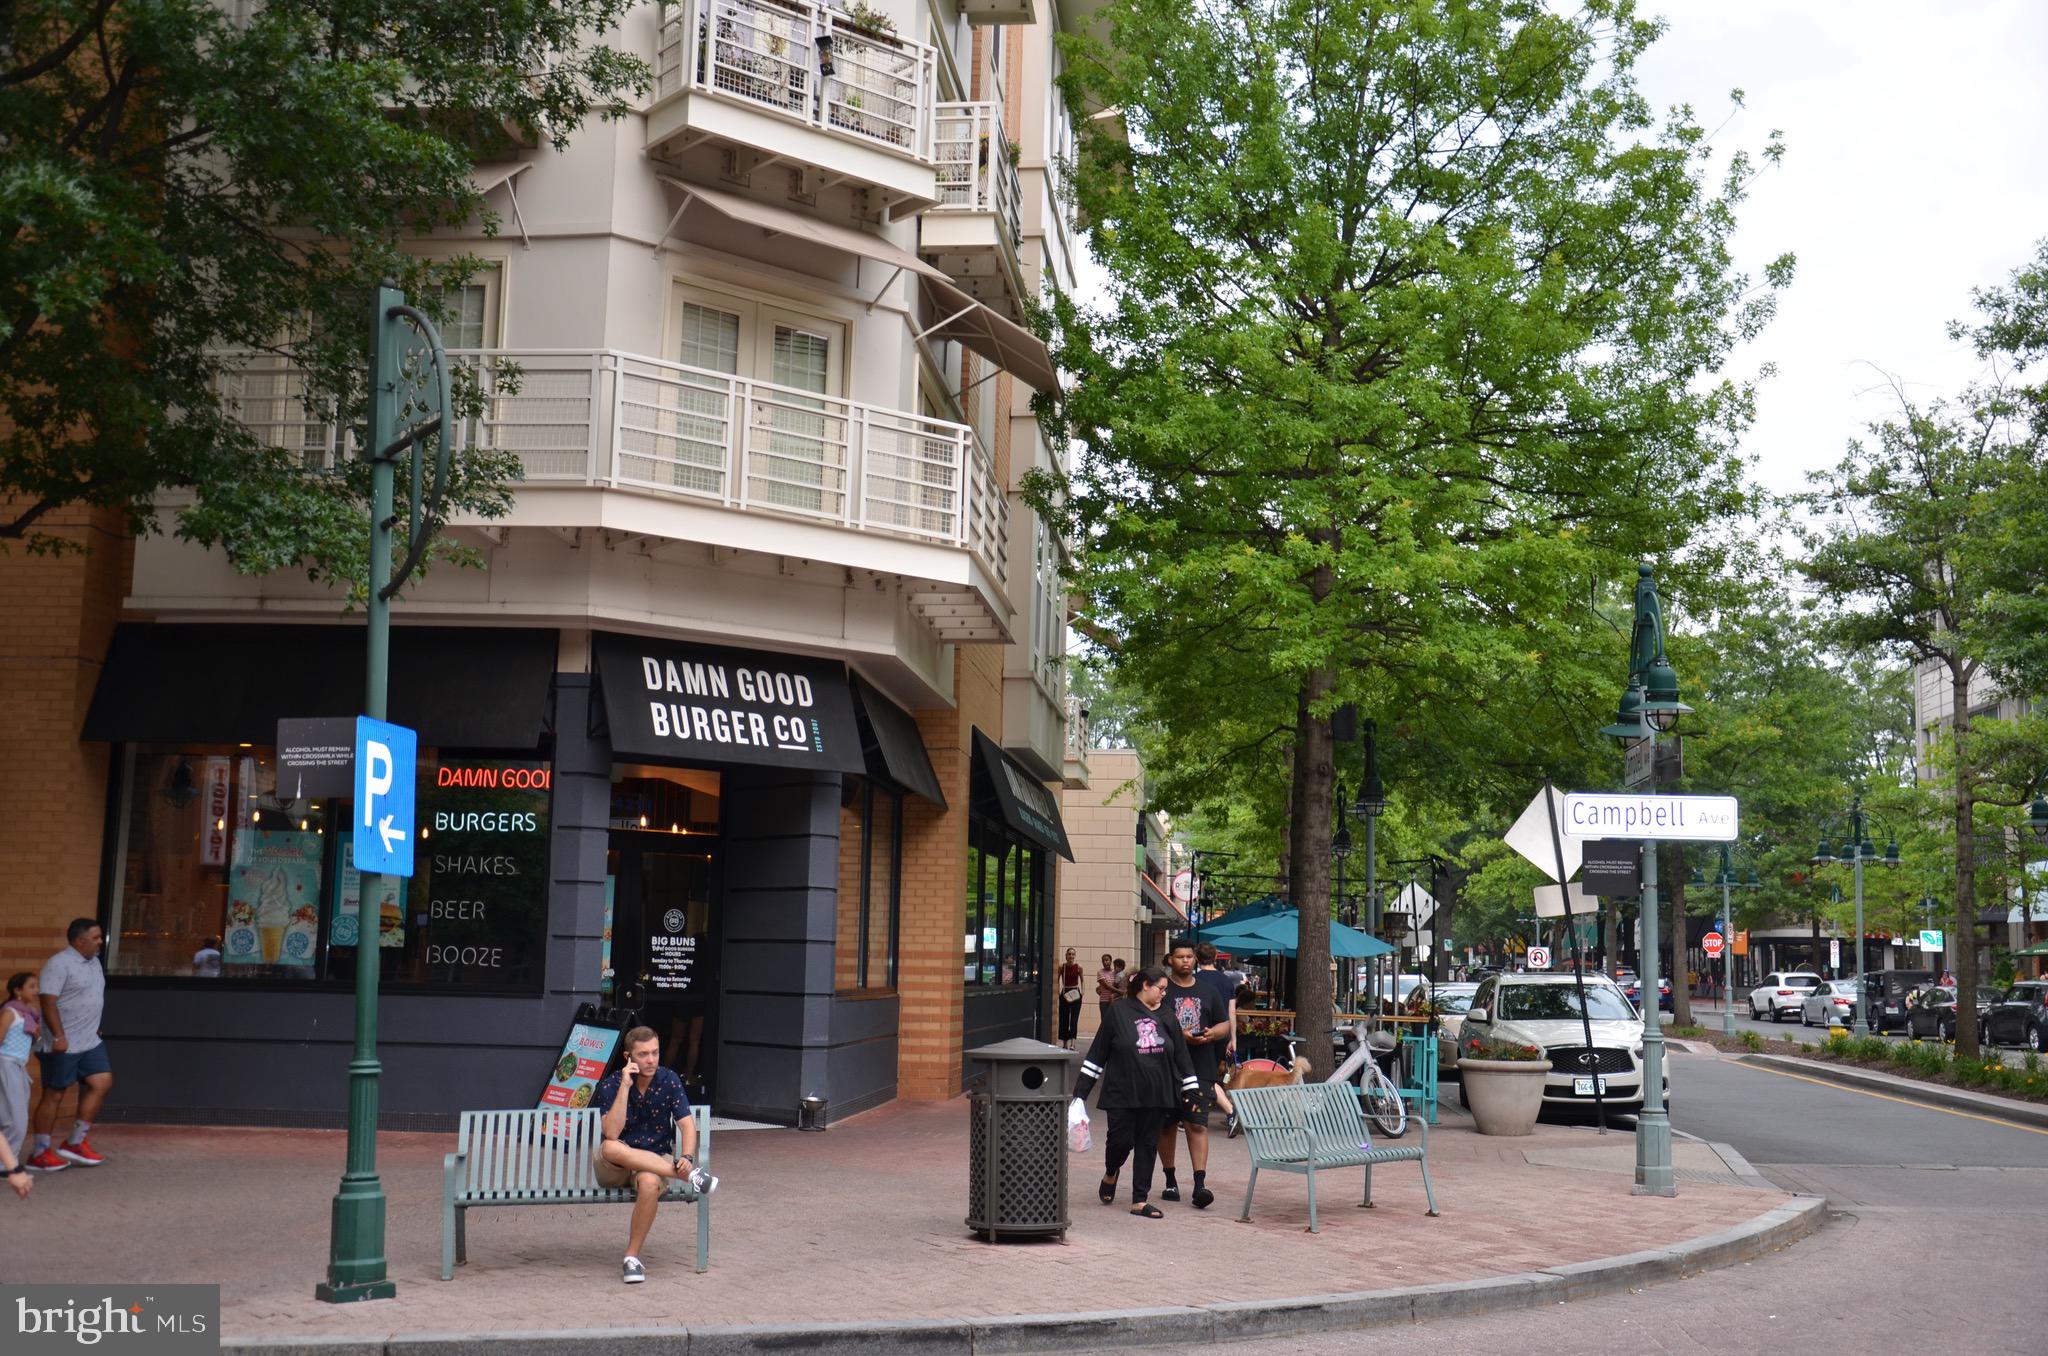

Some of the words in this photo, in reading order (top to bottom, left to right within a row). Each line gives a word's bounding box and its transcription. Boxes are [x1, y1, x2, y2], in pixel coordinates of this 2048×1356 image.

[642, 656, 729, 699] DAMN
[736, 668, 813, 708] GOOD
[650, 702, 769, 747] BURGER
[773, 714, 807, 743] CO
[364, 740, 393, 827] P
[438, 767, 498, 788] DAMN
[435, 812, 536, 832] BURGERS
[1573, 801, 1685, 832] Campbell
[1698, 811, 1730, 825] Ave
[434, 854, 516, 875] SHAKES
[431, 901, 485, 920] BEER
[651, 936, 668, 946] BIG
[670, 937, 696, 947] BUNS
[1704, 939, 1723, 948] STOP
[426, 945, 503, 968] BOOZE
[579, 1036, 606, 1050] BOWLS
